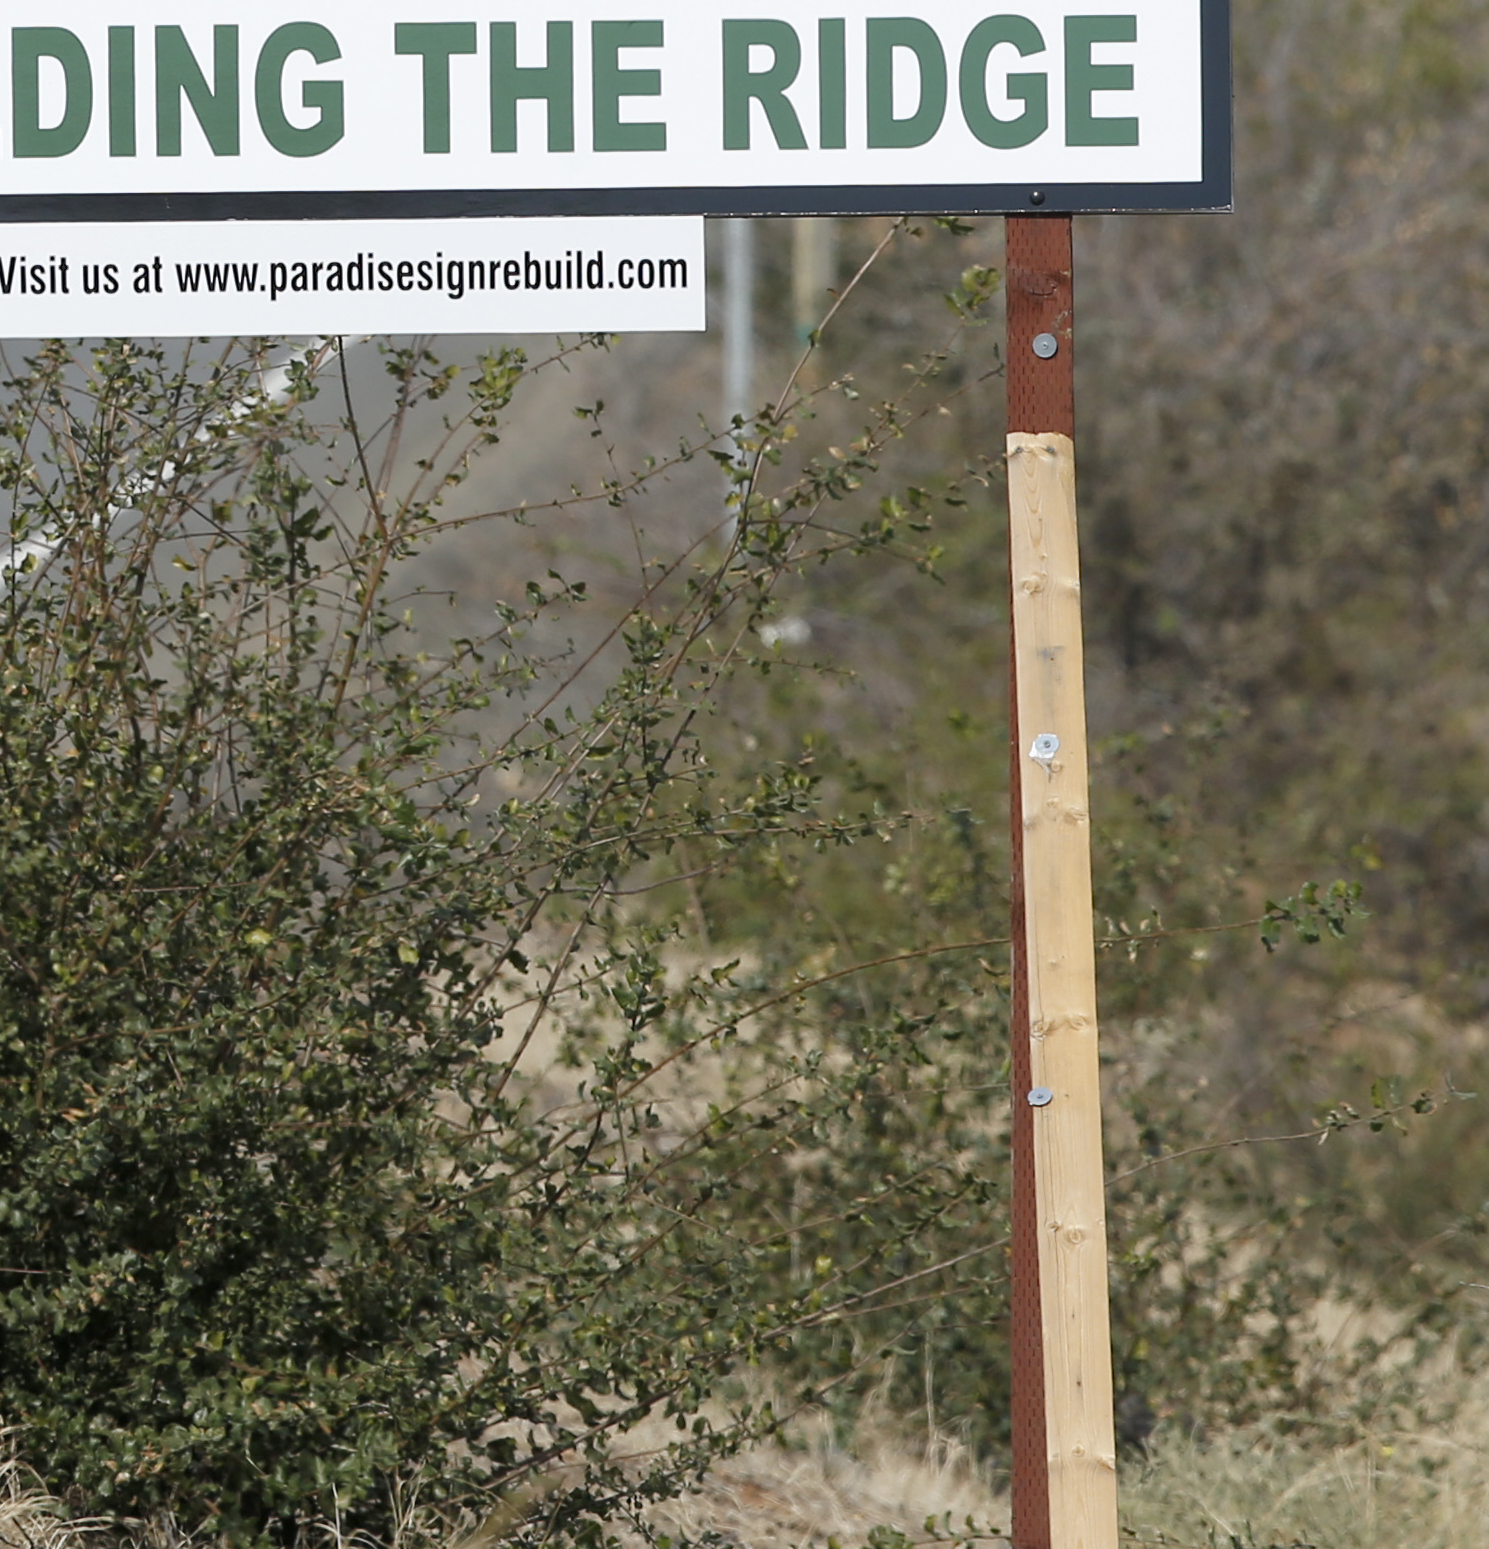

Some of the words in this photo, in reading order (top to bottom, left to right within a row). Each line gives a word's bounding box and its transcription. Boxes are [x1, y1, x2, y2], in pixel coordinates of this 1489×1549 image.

[393, 19, 669, 155] THE
[721, 13, 1141, 151] RIDGE
[82, 263, 120, 295] us
[132, 255, 163, 294] at
[175, 250, 689, 302] www.paradisesignrebuild.com
